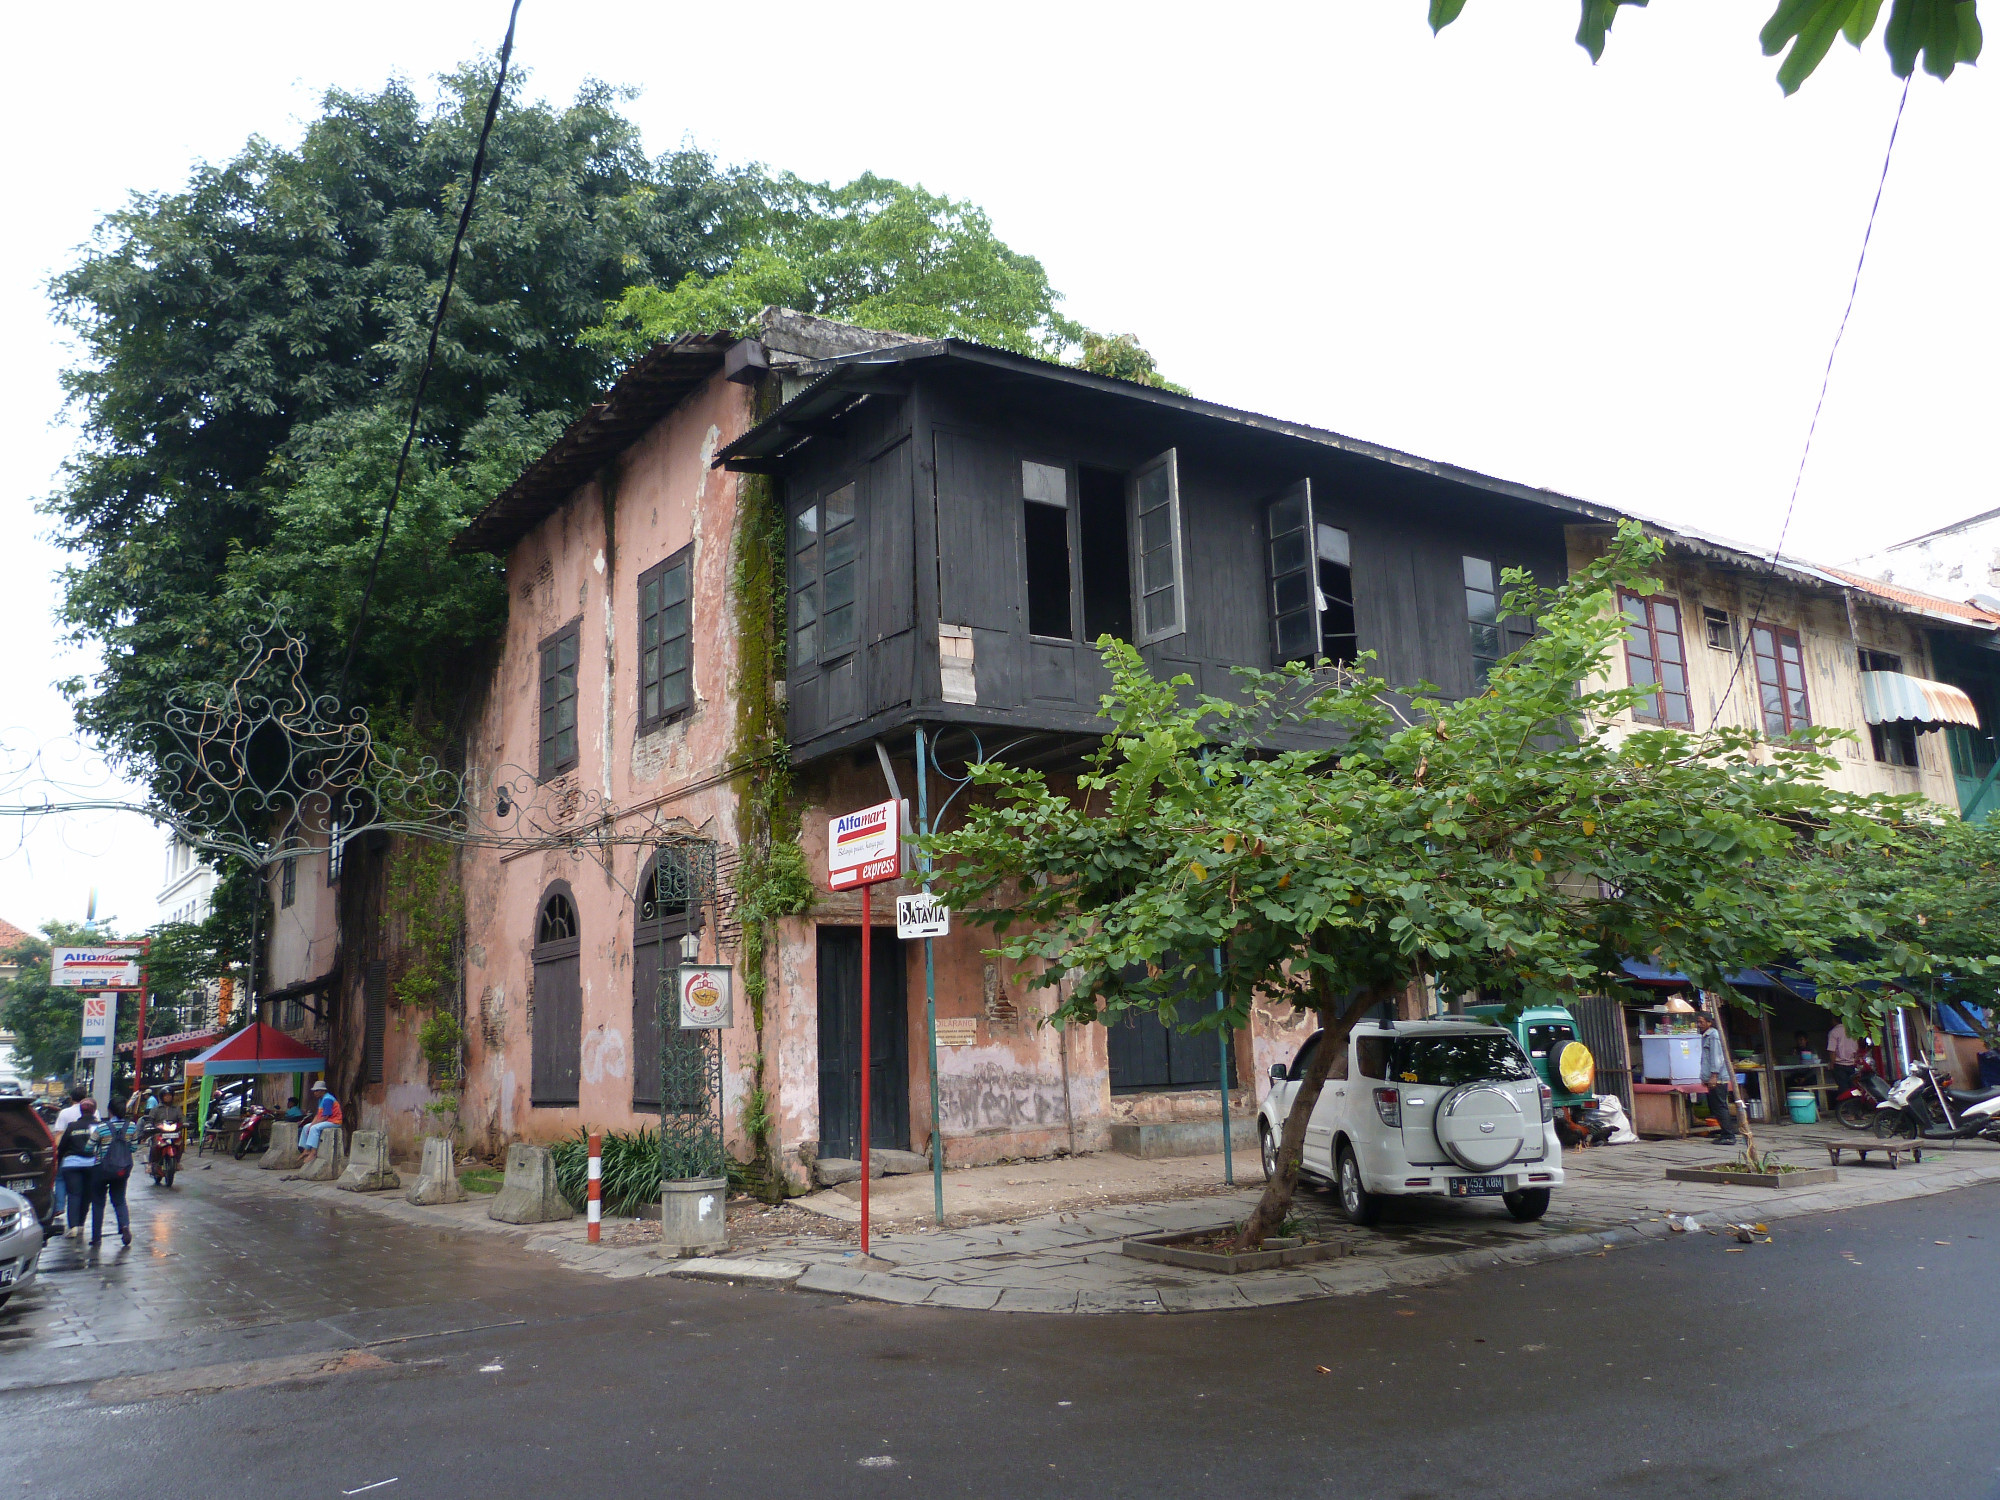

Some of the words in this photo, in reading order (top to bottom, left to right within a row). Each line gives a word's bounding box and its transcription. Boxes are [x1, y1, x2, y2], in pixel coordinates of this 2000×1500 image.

[837, 807, 887, 833] Alfamart
[863, 859, 895, 879] express
[899, 901, 945, 926] BATAVIA
[86, 1018, 104, 1026] BNI
[1452, 1179, 1458, 1188] B
[1465, 1177, 1484, 1188] 1452
